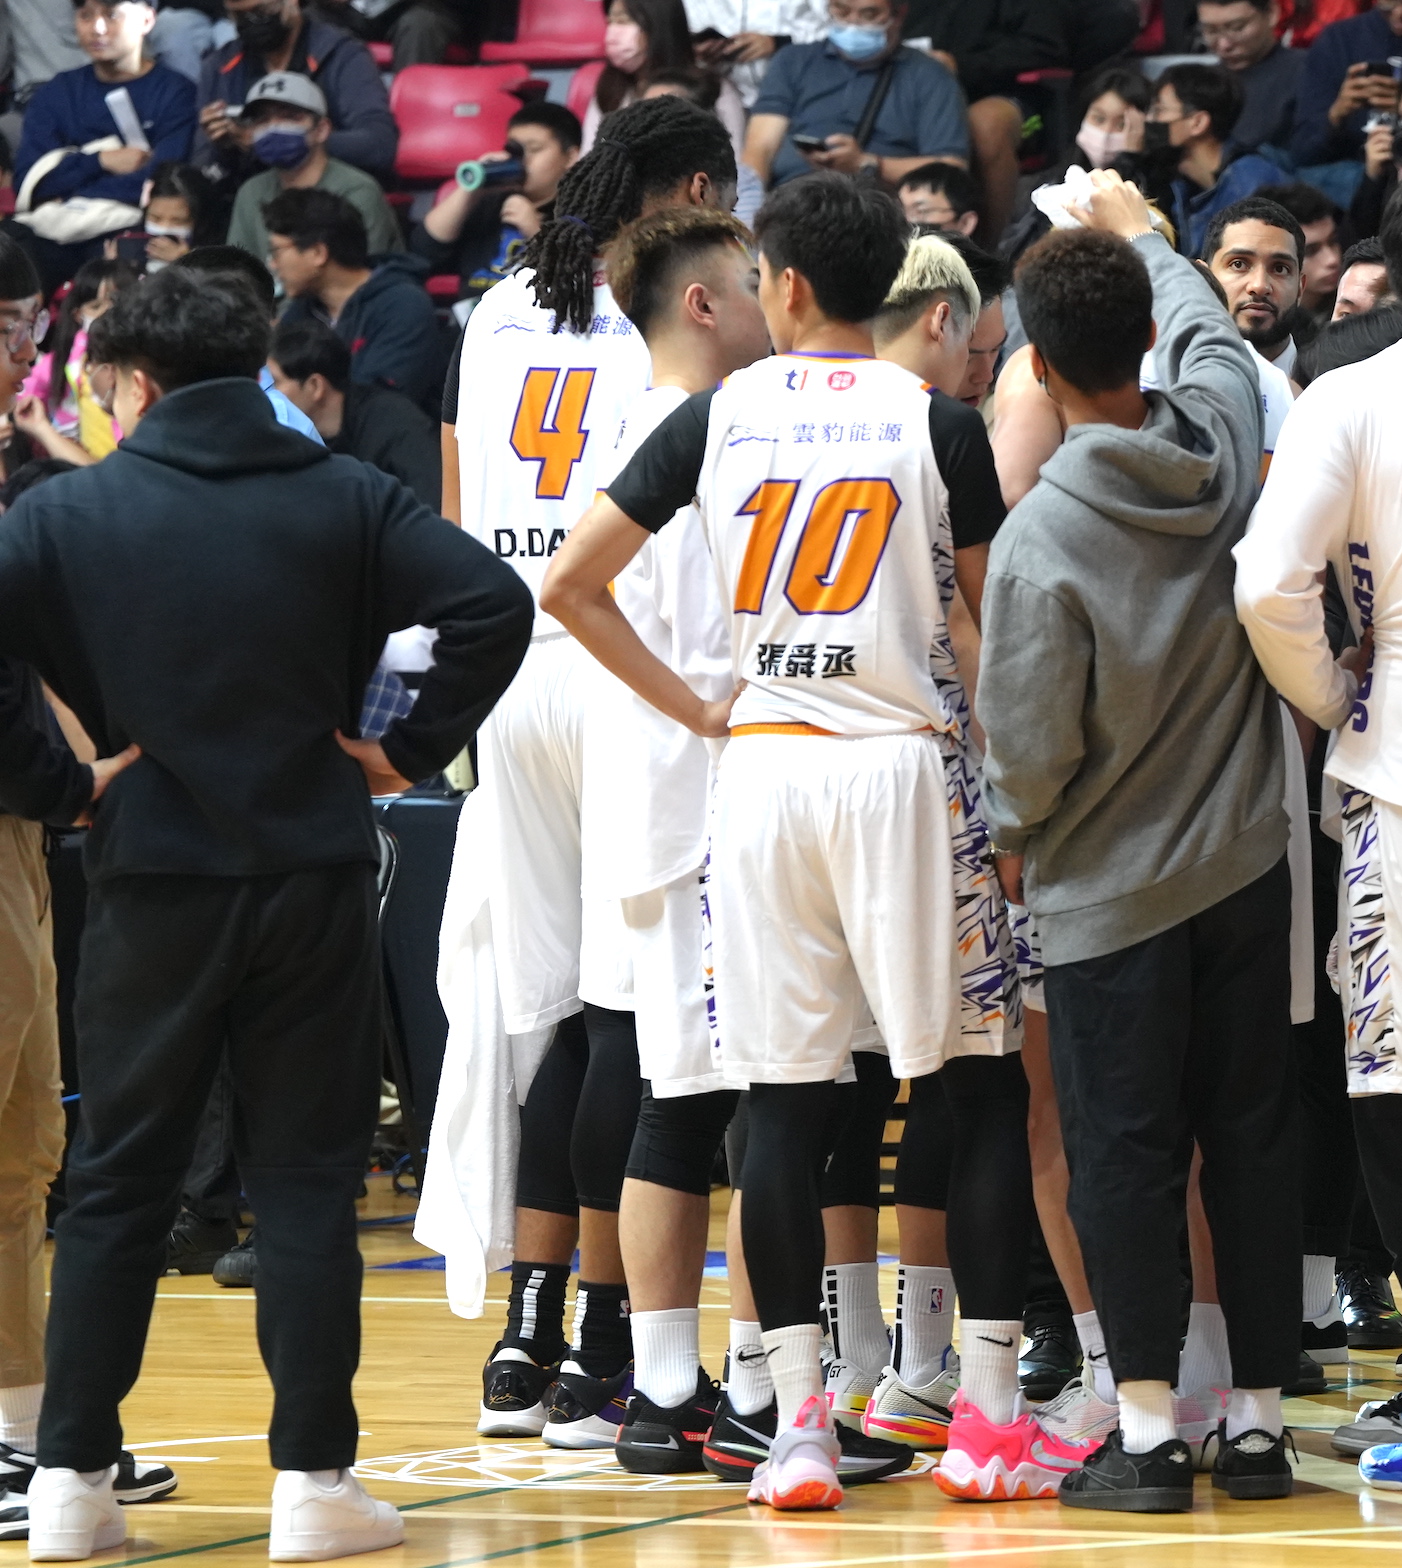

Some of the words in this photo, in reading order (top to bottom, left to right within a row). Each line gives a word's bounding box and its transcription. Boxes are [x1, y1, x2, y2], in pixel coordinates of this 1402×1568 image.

[508, 366, 598, 501] 4
[792, 421, 903, 443] 雲豹能源
[494, 528, 573, 558] D.DA
[733, 476, 903, 616] 10
[756, 643, 858, 679] 張舜丞
